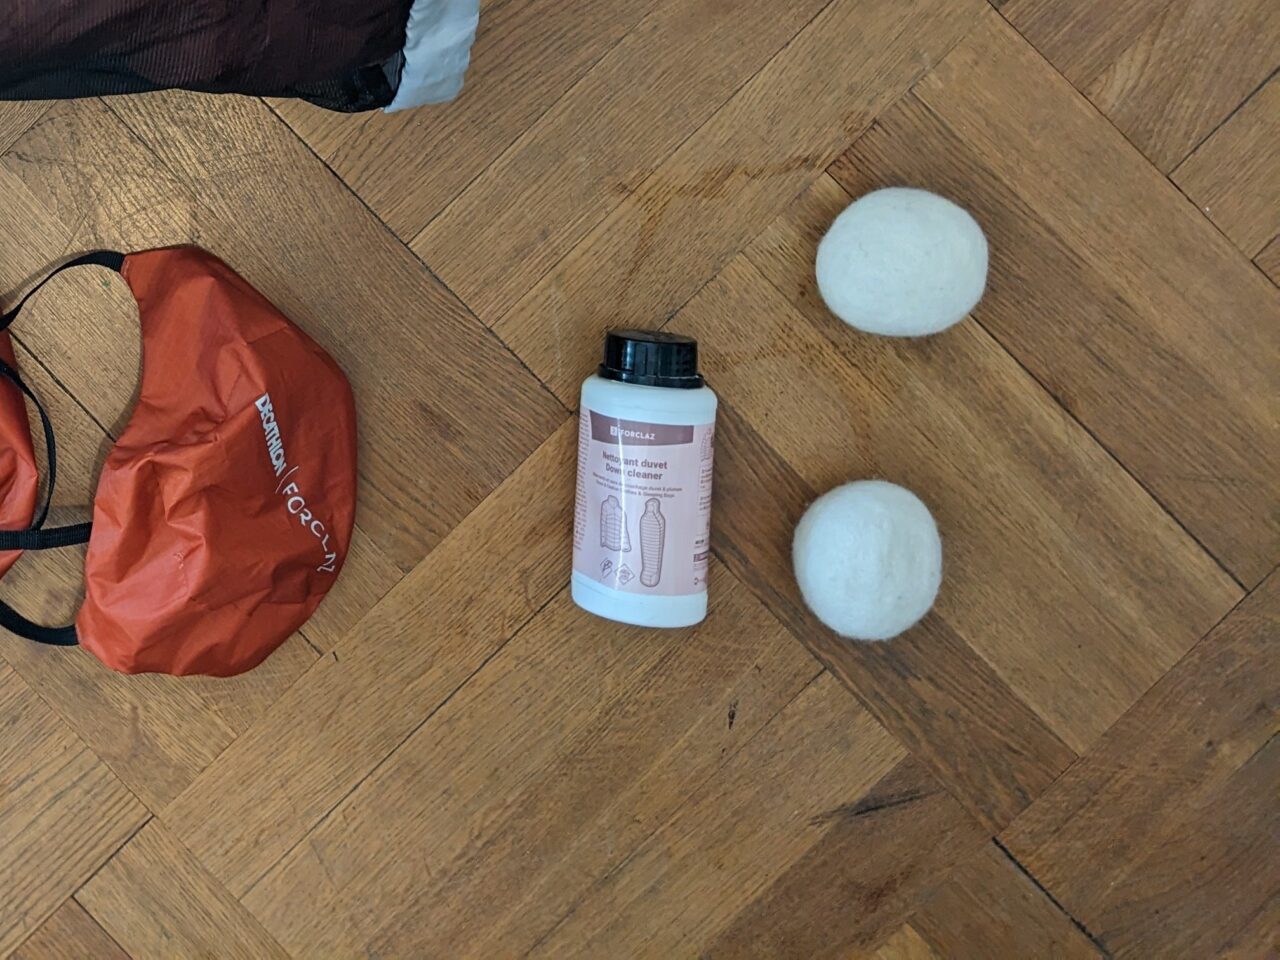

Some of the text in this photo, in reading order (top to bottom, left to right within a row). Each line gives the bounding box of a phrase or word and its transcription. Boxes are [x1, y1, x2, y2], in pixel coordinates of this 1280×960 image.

[255, 393, 287, 477] DECATHLON
[641, 458, 668, 470] duvet
[627, 469, 664, 481] cleaner
